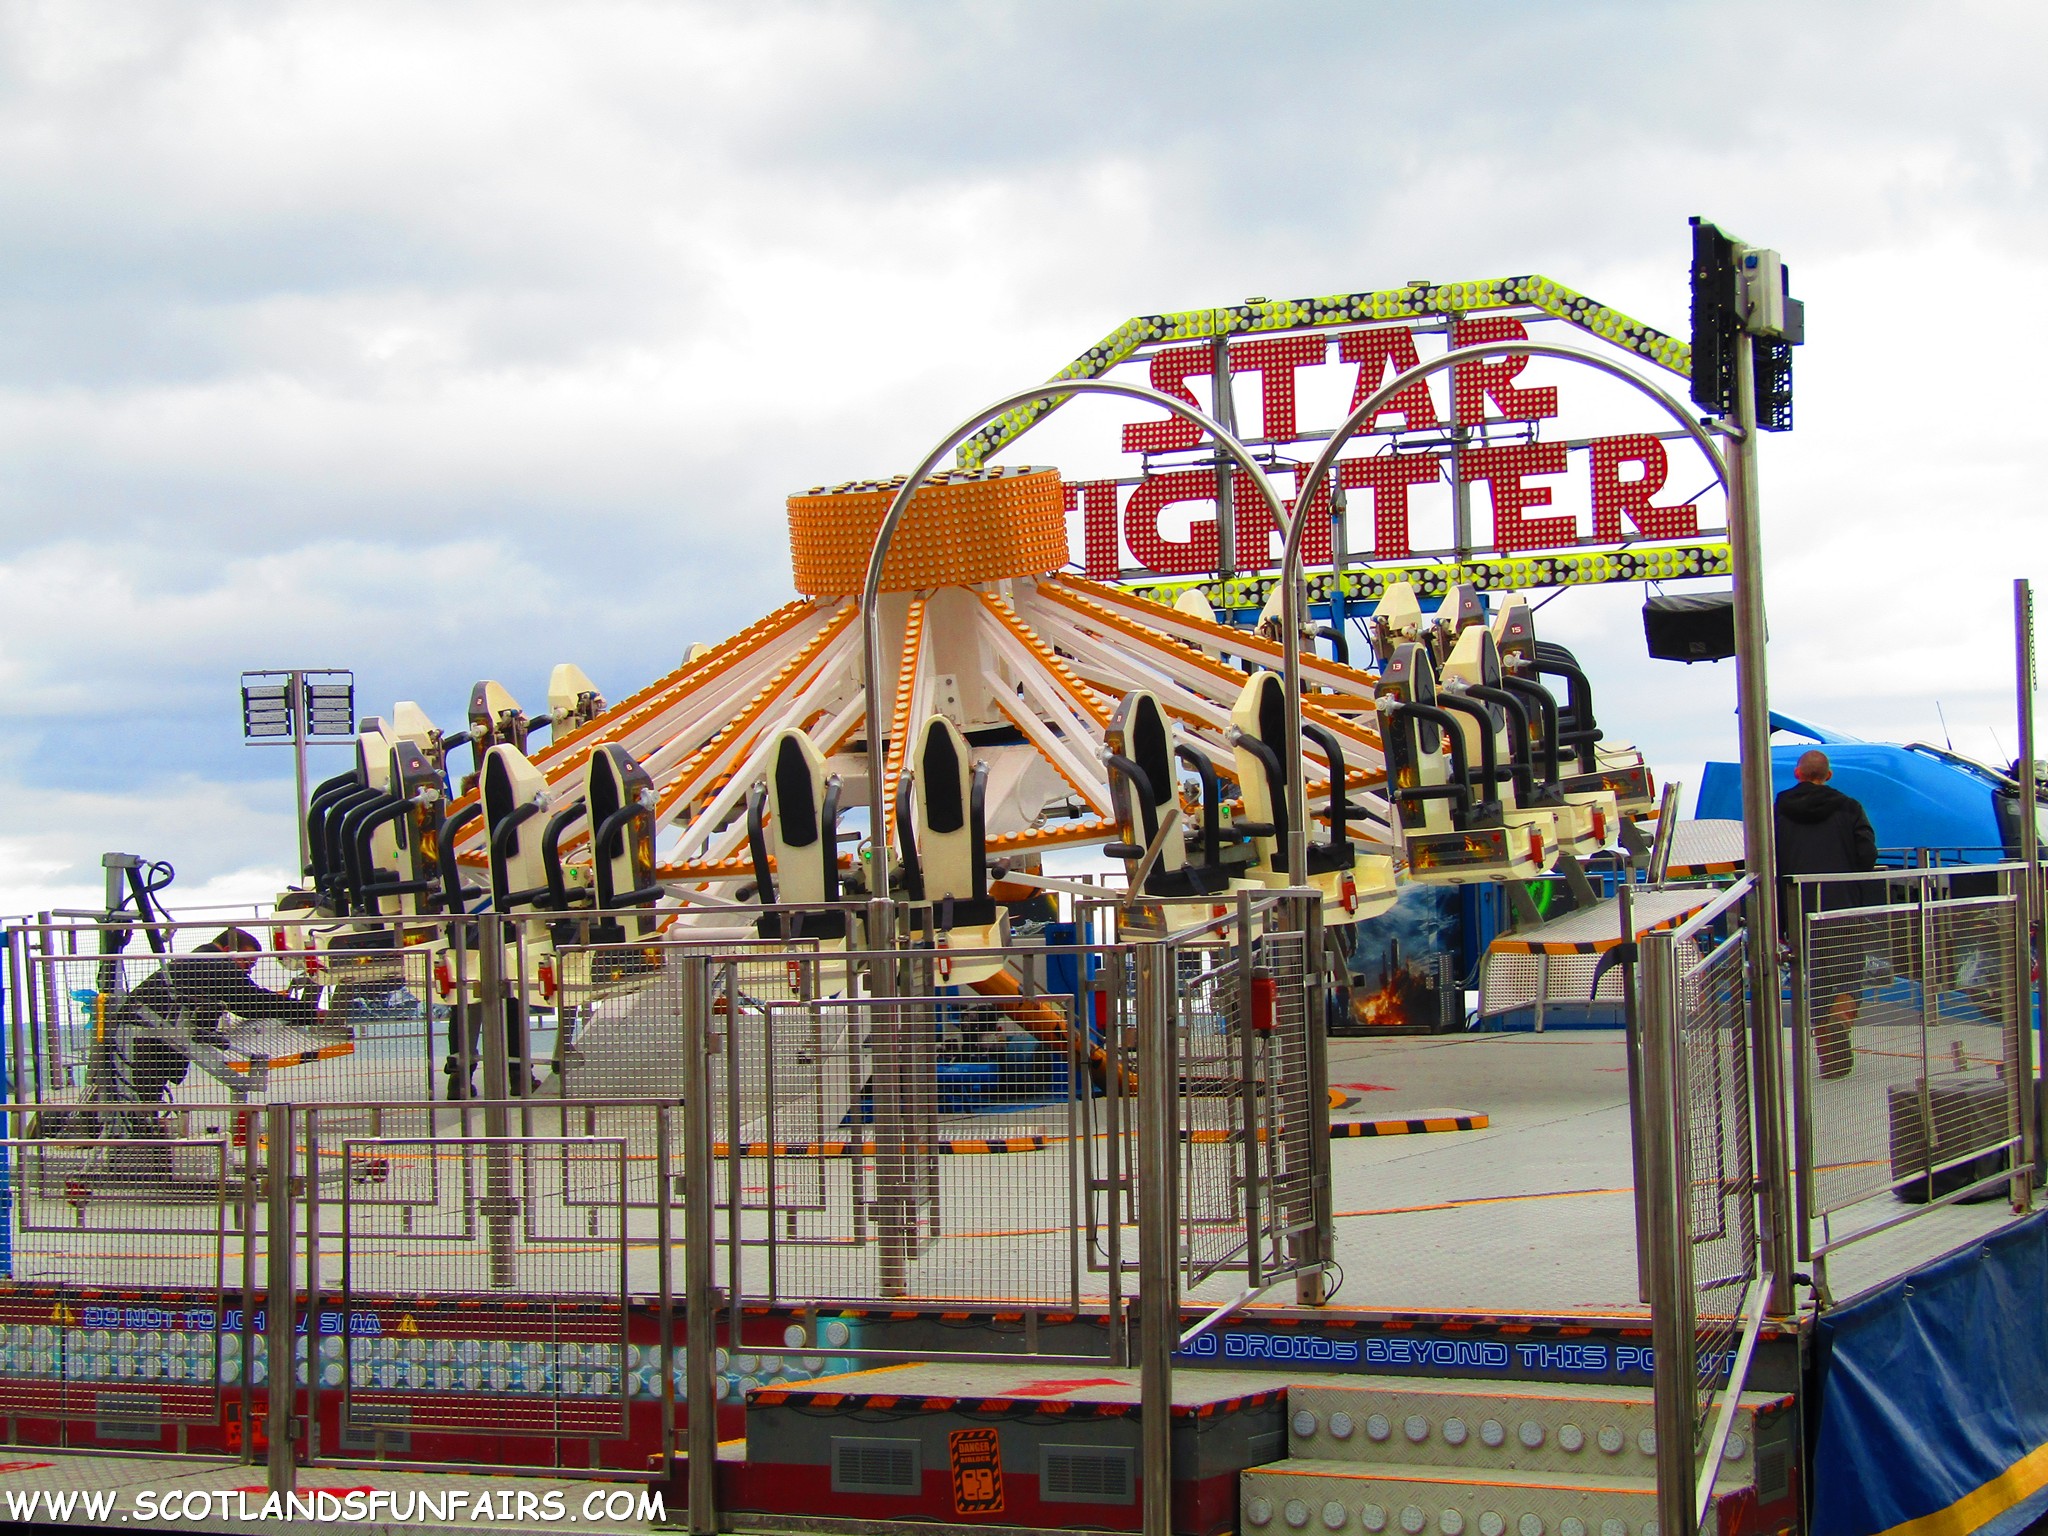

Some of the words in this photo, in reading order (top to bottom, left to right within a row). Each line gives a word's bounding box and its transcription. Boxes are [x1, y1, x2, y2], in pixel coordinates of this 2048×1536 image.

[1122, 316, 1558, 453] STAR
[1062, 433, 1697, 581] IGHTER
[1511, 626, 1521, 634] 15
[85, 1306, 120, 1326] DO
[126, 1307, 177, 1328] NOT
[1225, 1333, 1358, 1360] DROIDS
[1366, 1338, 1508, 1366] BEYOND
[1515, 1343, 1607, 1370] THIS
[1616, 1346, 1738, 1374] PONT
[958, 1441, 990, 1454] DANGER
